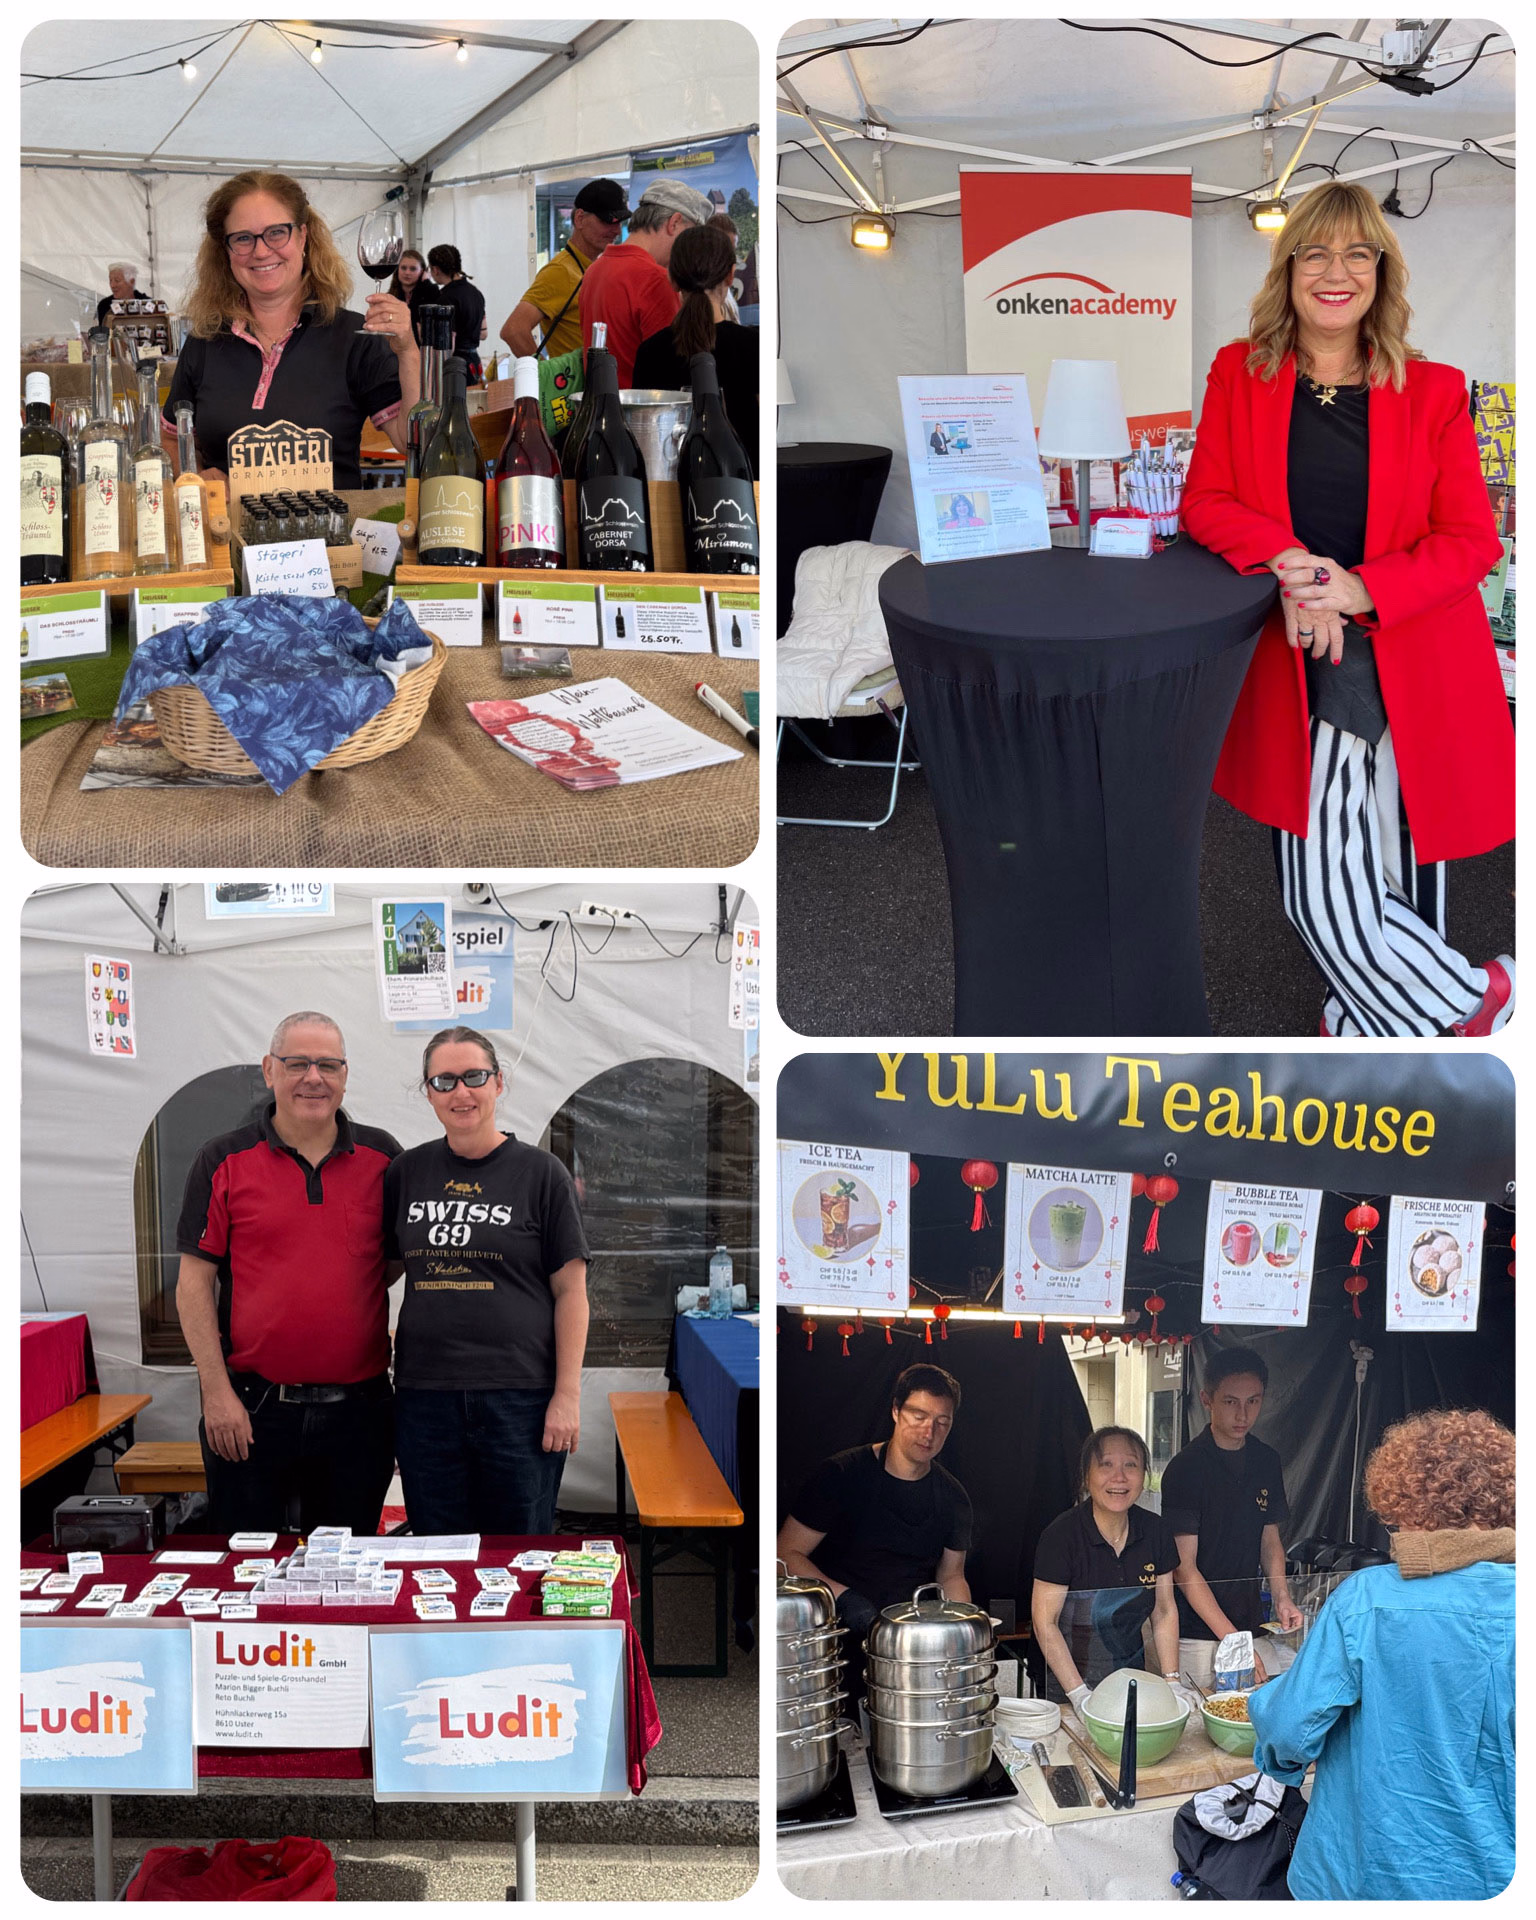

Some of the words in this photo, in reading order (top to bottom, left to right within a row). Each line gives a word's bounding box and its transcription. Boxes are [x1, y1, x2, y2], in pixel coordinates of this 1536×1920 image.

[996, 292, 1178, 321] onkenacademy
[231, 438, 331, 467] STÄGERI
[232, 467, 331, 479] GRAPPINIO
[421, 526, 466, 541] AUSLESE
[501, 522, 556, 548] PiNK!
[588, 530, 634, 542] CABERNET
[595, 539, 627, 548] DORSA
[256, 571, 280, 584] Kiste
[875, 1052, 1078, 1122] YuLu
[1105, 1055, 1436, 1158] Teahouse
[808, 1144, 832, 1158] ICE
[834, 1147, 862, 1161] TEA
[799, 1158, 822, 1166] FRISCH
[828, 1161, 875, 1172] HAUSGEMACHT
[1025, 1167, 1078, 1183] MATCHA
[1080, 1172, 1117, 1186] LATTE
[1235, 1186, 1277, 1199] BUBBLE
[1279, 1190, 1299, 1201] TEA
[407, 1200, 513, 1226] SWISS
[1403, 1200, 1442, 1212] FRISCHE
[1442, 1202, 1473, 1213] MOCHI
[428, 1223, 472, 1247] 69
[425, 1249, 450, 1258] TASTE
[450, 1249, 461, 1258] OF
[462, 1250, 504, 1261] HELVETIA
[215, 1630, 316, 1667] Ludit
[318, 1659, 347, 1668] GmbH
[215, 1673, 241, 1682] Puzzle-
[241, 1674, 256, 1682] und
[257, 1674, 327, 1684] Spiele-Grosshandel
[215, 1683, 241, 1691] Marion
[242, 1684, 266, 1693] Bigger
[267, 1684, 290, 1692] Buchli
[215, 1693, 232, 1701] Reto
[233, 1693, 256, 1702] Buchli
[20, 1691, 133, 1734] Ludit
[438, 1694, 563, 1739] Ludit
[215, 1720, 234, 1728] 8610
[234, 1720, 255, 1728] Uster
[215, 1730, 263, 1739] www.ludit.ch
